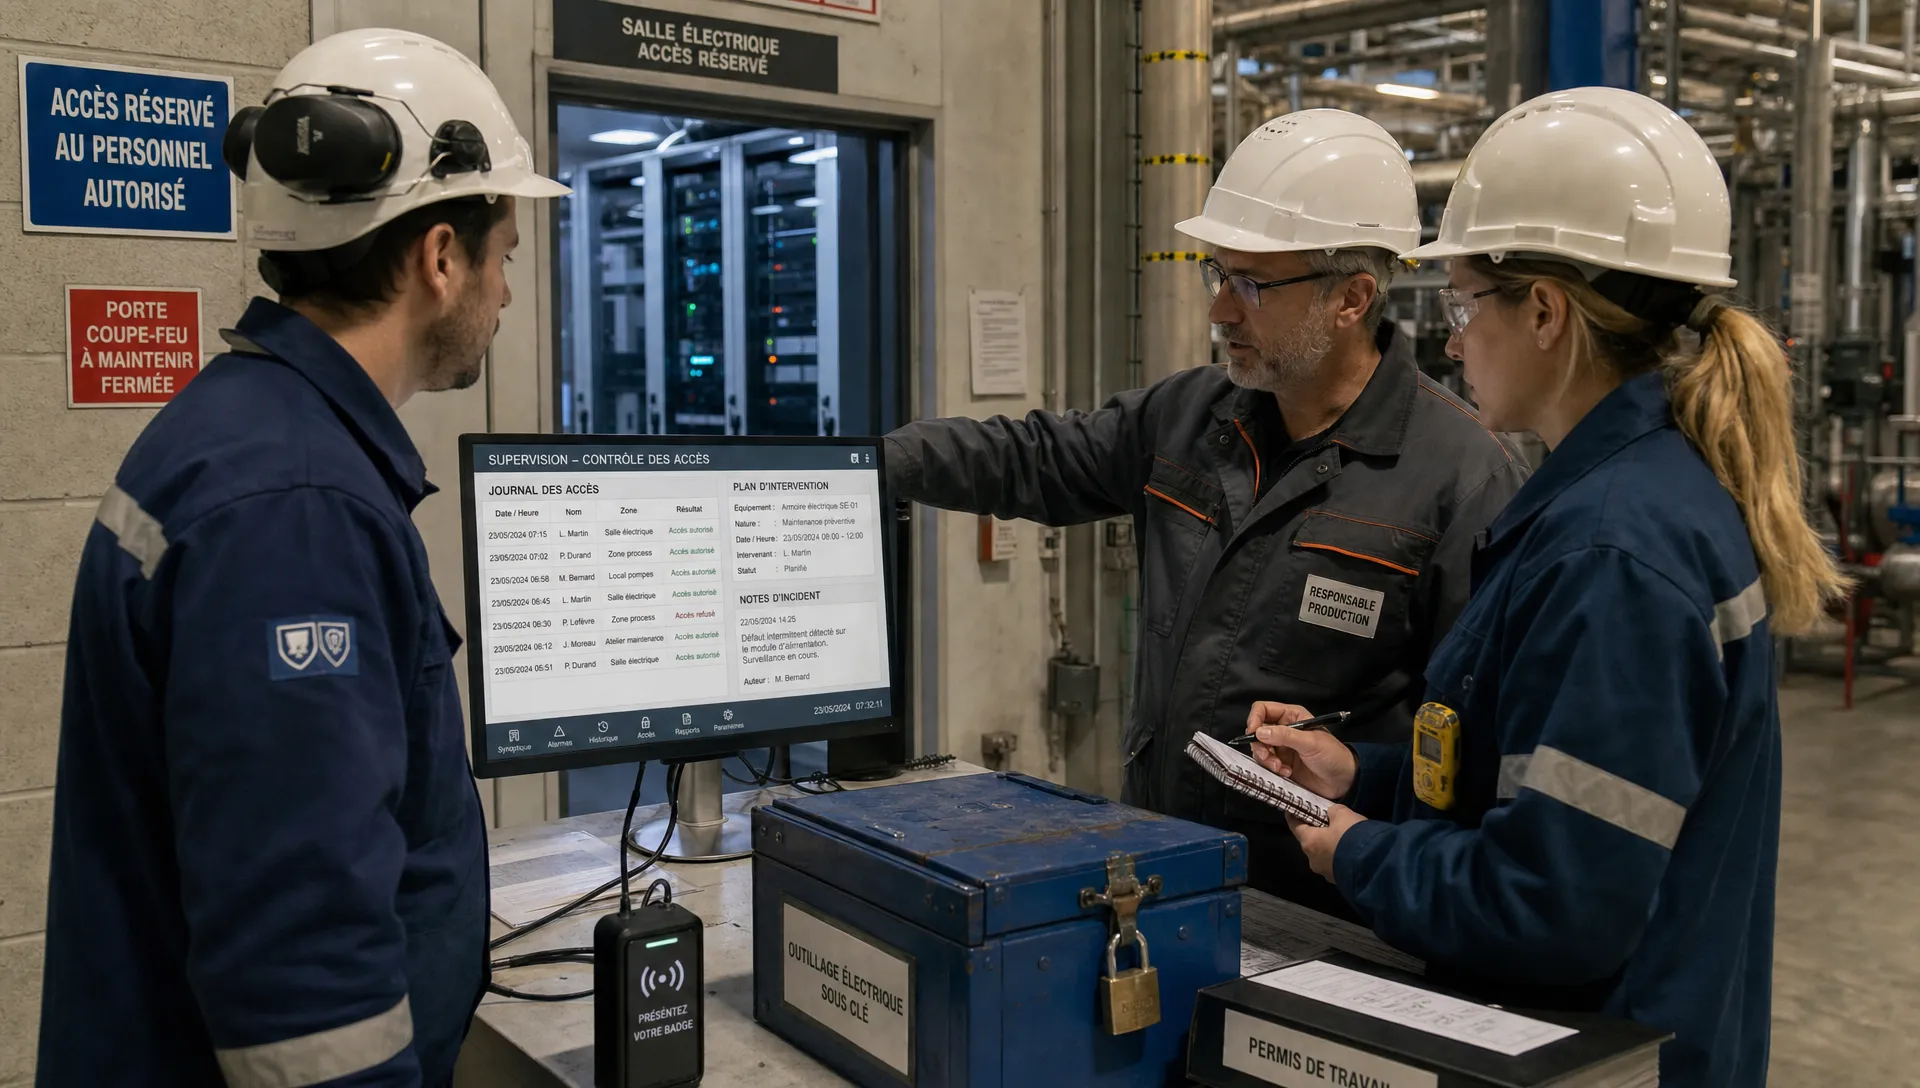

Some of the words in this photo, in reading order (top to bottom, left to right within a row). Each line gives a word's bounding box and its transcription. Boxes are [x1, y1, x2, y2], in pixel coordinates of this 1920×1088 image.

[622, 17, 675, 40] SALLE
[682, 22, 780, 56] ÉLECTRIQUE
[638, 42, 693, 64] ACCÈS
[698, 48, 768, 75] RÉSERVÉ
[51, 85, 118, 122] ACCÈS
[125, 89, 215, 128] RÉSERVÉ
[55, 133, 85, 161] AU
[92, 136, 212, 169] PERSONNEL
[84, 176, 186, 211] AUTORISÉ
[106, 300, 167, 319] PORTE
[86, 325, 188, 344] COUPE-FEU
[81, 346, 93, 368] À
[98, 351, 194, 369] MAINTENIR
[101, 372, 174, 394] FERMÉE
[488, 454, 568, 466] SUPERVISION
[582, 452, 644, 465] CONTRÔLE
[648, 454, 670, 464] DES
[674, 452, 710, 464] ACCÈS
[489, 486, 538, 496] JOURNAL
[542, 485, 562, 495] DES
[566, 482, 599, 494] ACCÈS
[733, 482, 756, 491] PLAN
[759, 482, 829, 491] D'INTERVENTION
[808, 502, 838, 510] électrique
[490, 554, 527, 562] 23/05/2024
[628, 571, 653, 580] pompes
[492, 599, 529, 607] 23/05/2024
[625, 592, 656, 600] électrique
[740, 594, 769, 604] NOTES
[773, 591, 820, 602] D'INCIDENT
[1310, 586, 1376, 611] RESPONSABLE
[630, 615, 655, 623] process
[1308, 602, 1369, 626] PRODUCTION
[493, 622, 530, 630] 23/05/2024
[740, 617, 776, 626] 22/05/2024
[742, 633, 765, 642] Défaut
[767, 631, 807, 640] intermittent
[809, 628, 834, 637] détecté
[494, 645, 531, 653] 23/05/2024
[751, 644, 776, 652] module
[628, 657, 659, 665] électrique
[743, 654, 785, 664] Surveillance
[495, 666, 532, 675] 23/05/2024
[785, 673, 810, 681] Bernard
[814, 703, 851, 714] 23/05/2024
[788, 941, 840, 980] OUTILLAGE
[842, 965, 904, 1016] ÉLECTRIQUE
[821, 984, 846, 1012] SOUS
[849, 998, 869, 1023] CLÉ
[634, 1026, 662, 1041] VOTRE
[665, 1020, 693, 1034] BADGE
[1249, 1036, 1302, 1070] PERMIS
[1305, 1057, 1325, 1078] DE
